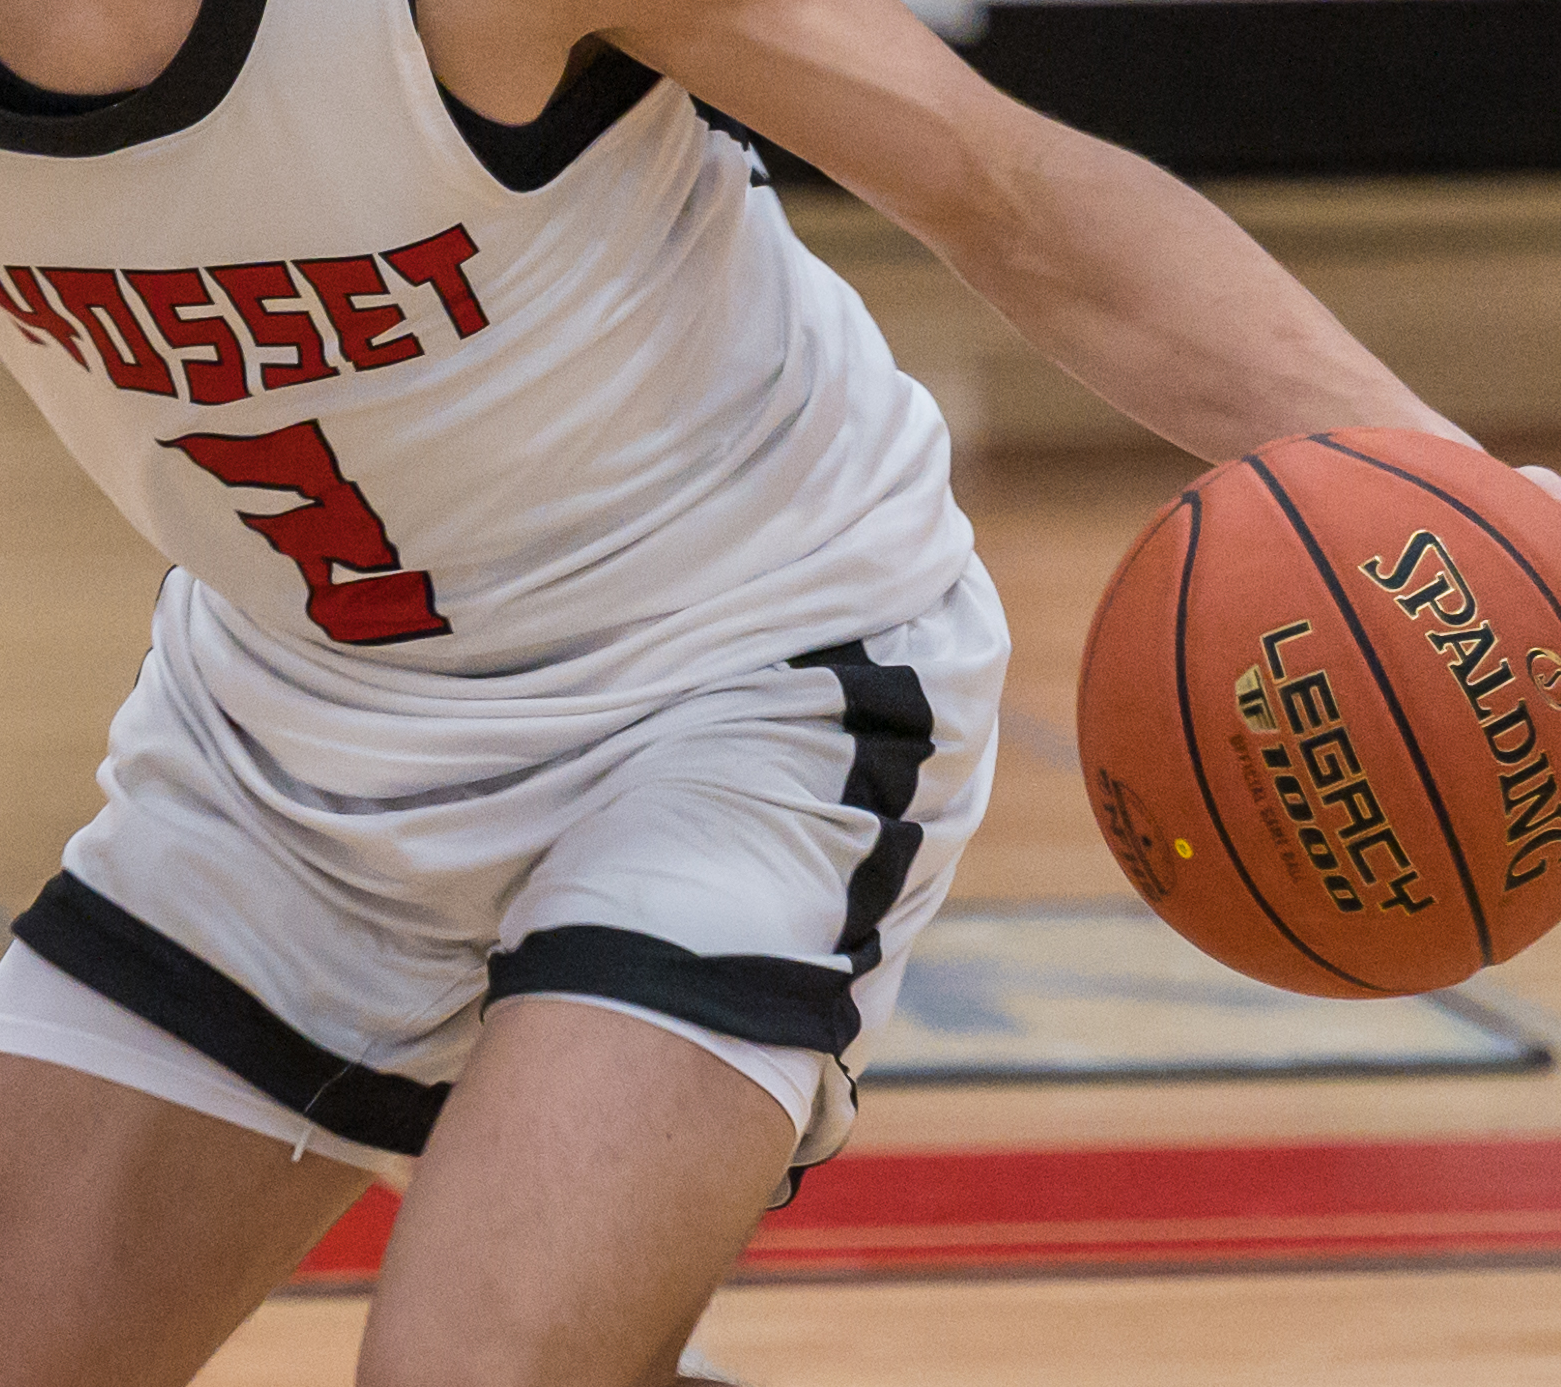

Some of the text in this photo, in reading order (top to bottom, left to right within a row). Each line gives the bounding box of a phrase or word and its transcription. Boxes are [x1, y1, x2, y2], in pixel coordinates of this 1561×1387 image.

[155, 418, 454, 646] 2
[1260, 619, 1437, 915] LEGACY
[1261, 742, 1364, 913] 1000
